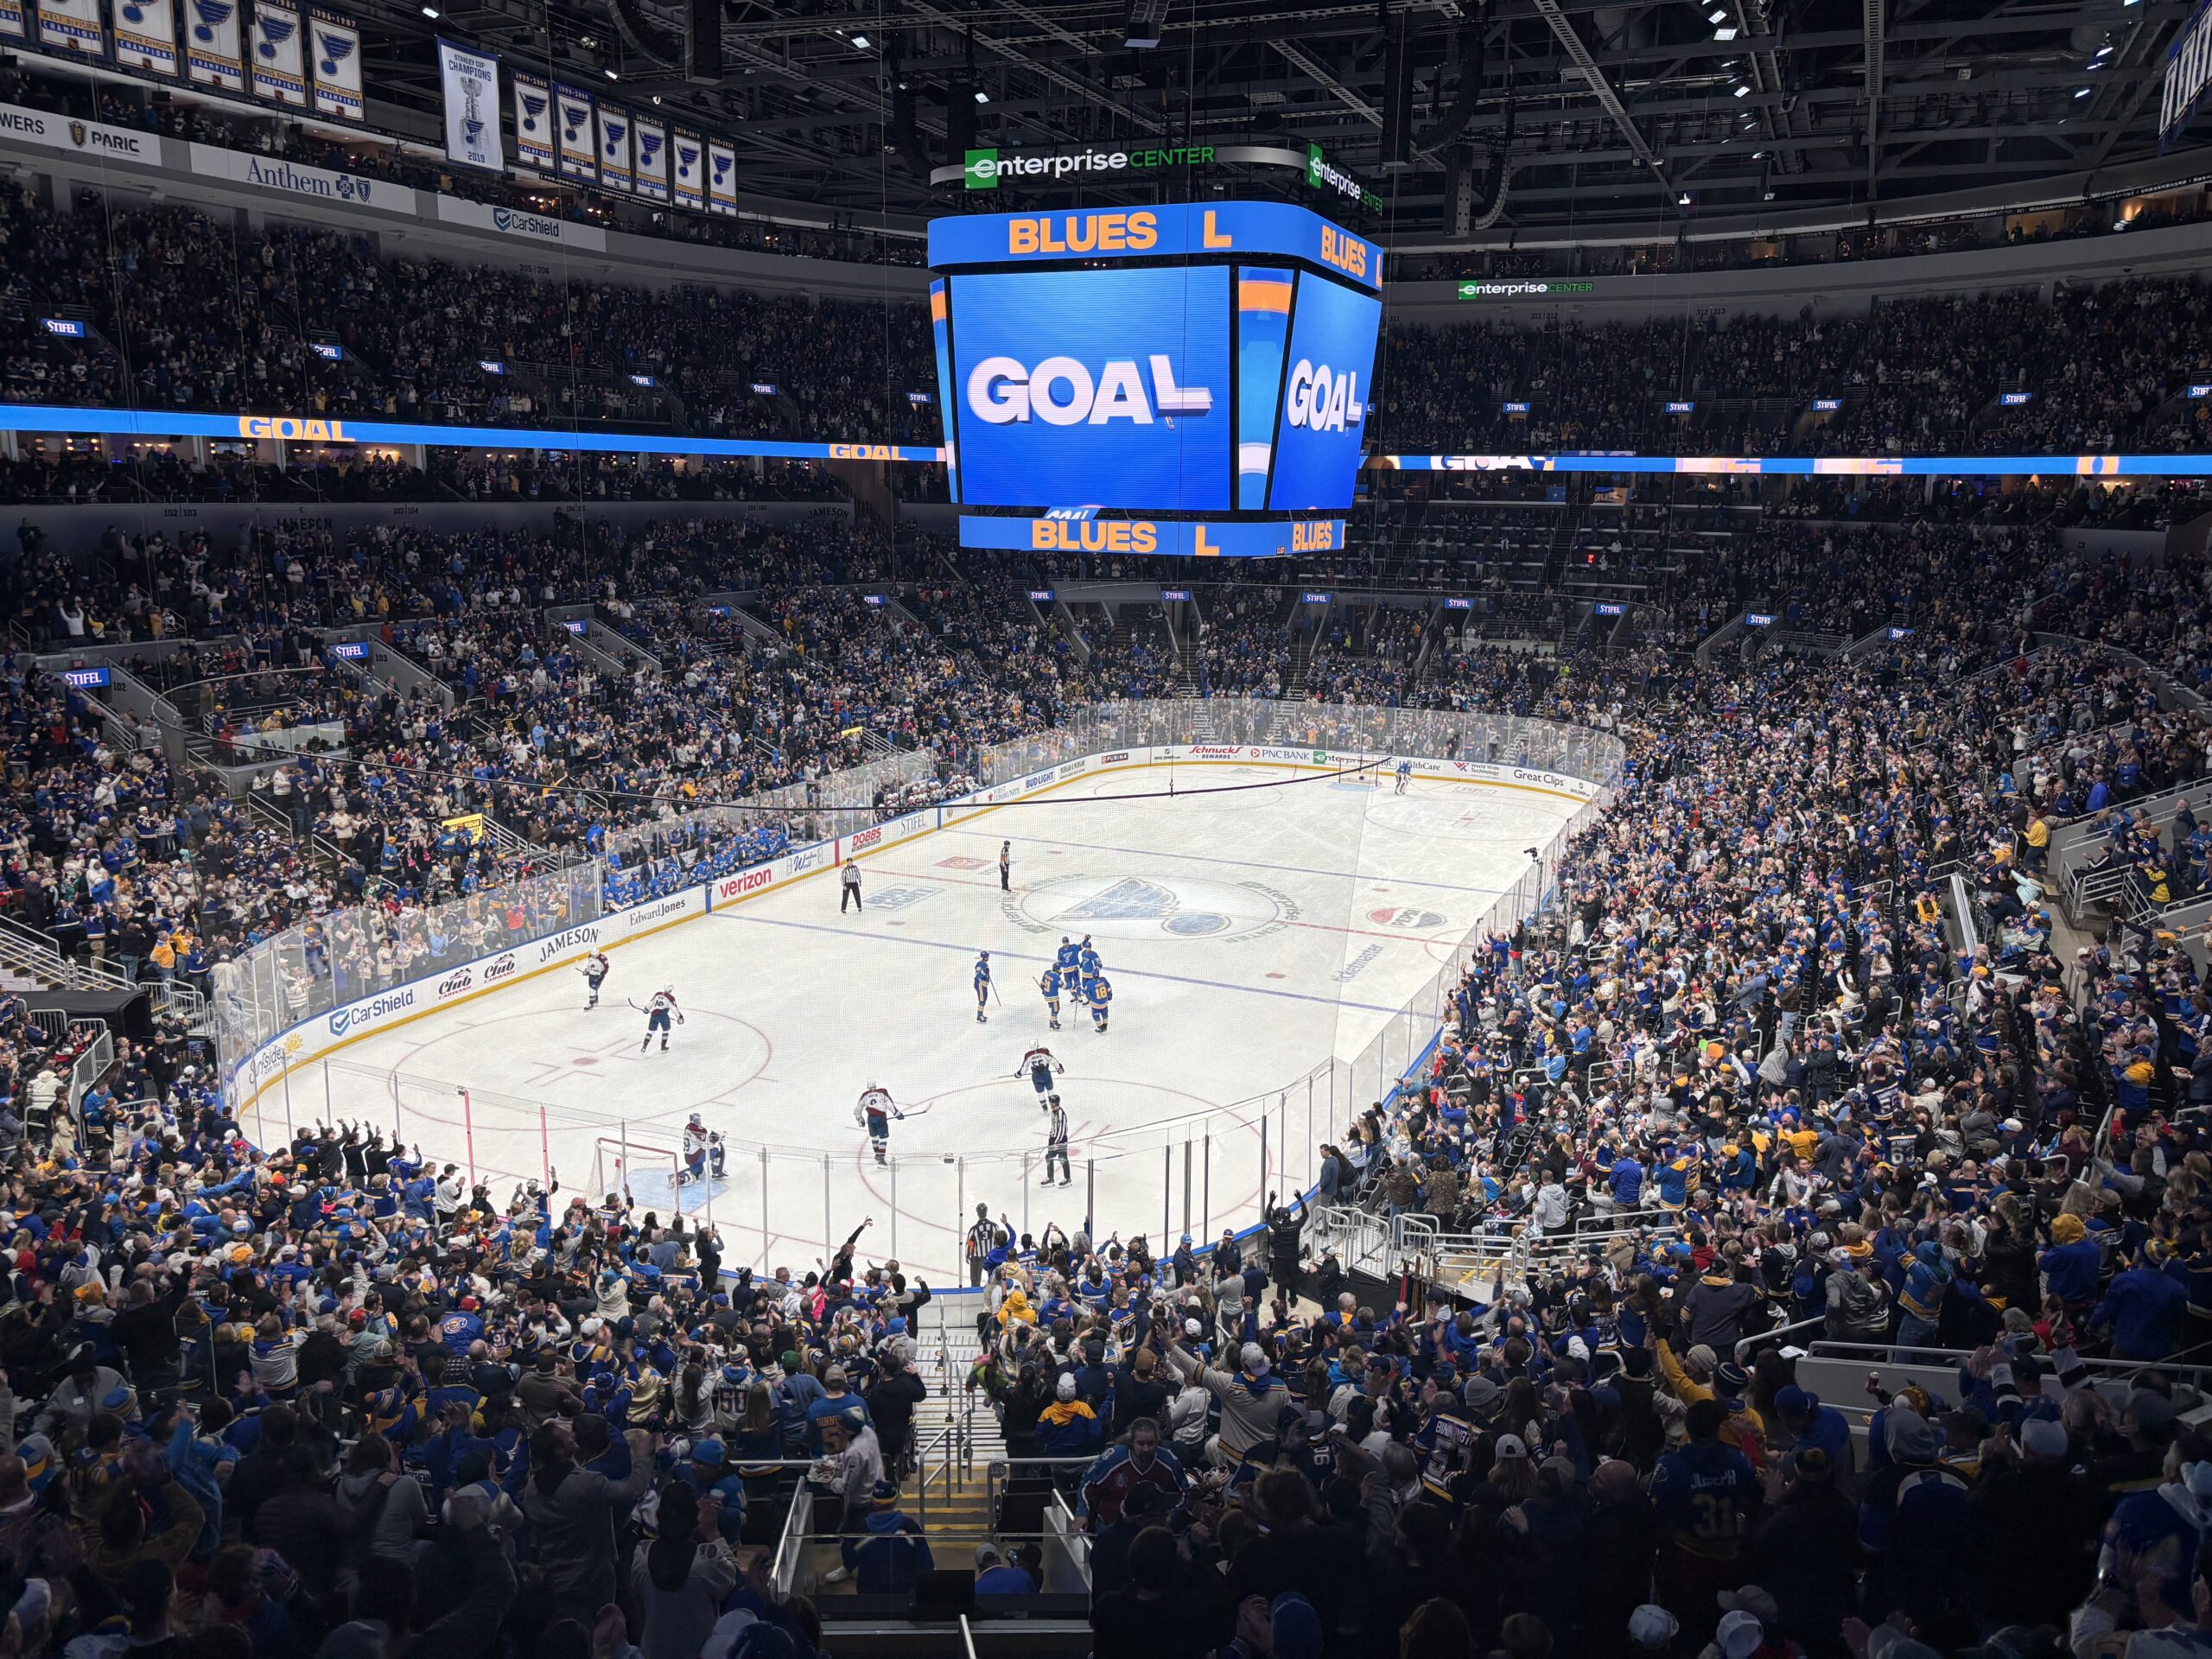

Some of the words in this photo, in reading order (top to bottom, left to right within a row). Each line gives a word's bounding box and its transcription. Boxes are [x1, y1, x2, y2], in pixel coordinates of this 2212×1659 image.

[43, 20, 99, 41] CHAMPIONS
[119, 40, 174, 60] CHAMPIONS
[192, 59, 240, 78] CHAMPIONS
[454, 54, 475, 66] STANLEY
[277, 72, 302, 84] DIVISION
[448, 60, 492, 82] CHAMPIONS
[256, 74, 302, 92] CHAMPIONS
[318, 90, 362, 107] CHAMPIONS
[339, 89, 360, 100] DIVISION
[92, 131, 140, 153] PARIC
[467, 151, 486, 162] 2019
[519, 144, 553, 159] CHAMPIONS
[965, 149, 1128, 178] enterprise
[1129, 146, 1215, 168] CENTER
[247, 156, 331, 196] Anthem
[1310, 156, 1360, 200] enterprise
[1360, 188, 1382, 213] CENTER
[512, 216, 559, 237] CarShield
[1009, 212, 1157, 253] BLUES
[1203, 211, 1232, 248] L
[1321, 225, 1366, 277] BLUES
[1459, 282, 1548, 296] enterprise
[1548, 282, 1594, 292] CENTER
[47, 321, 78, 334] STIFEL
[753, 385, 772, 393] STIFEL
[910, 393, 927, 402] STIFEL
[968, 354, 1212, 426] GOAL
[1287, 359, 1362, 433] GOAL
[1817, 401, 1837, 410] STIFEL
[239, 416, 354, 442] GOAL
[829, 444, 908, 461] GOAL
[164, 508, 178, 517] 102
[184, 508, 197, 518] 103
[808, 506, 849, 519] JAMESON
[276, 518, 332, 530] JAMESON
[1033, 520, 1157, 552] BLUES
[1194, 525, 1219, 556] L
[1292, 522, 1332, 551] BLUES
[1306, 594, 1326, 602] STIFEL
[1449, 599, 1469, 607] STIFEL
[1600, 605, 1621, 613] STIFEL
[336, 645, 363, 657] STIFEL
[375, 654, 388, 663] 103
[65, 672, 102, 685] STIFEL
[113, 682, 126, 691] 102
[1189, 746, 1243, 754] Schnucks
[1262, 749, 1283, 759] PNC
[1284, 751, 1309, 760] BANK
[1026, 776, 1038, 789] BUD
[1038, 772, 1054, 785] LIGHT
[1471, 768, 1499, 777] Technology
[1514, 770, 1542, 782] Great
[1543, 774, 1565, 787] Clips
[994, 787, 1020, 803] COMMUNITY
[995, 786, 1006, 796] FIRST
[900, 814, 926, 834] STIFEL
[852, 827, 881, 847] DOBBS
[720, 868, 772, 899] verizon
[630, 904, 661, 926] Edward
[660, 898, 686, 917] Jones
[1391, 908, 1422, 927] PEPSI
[540, 928, 599, 962] JAMESON
[484, 959, 516, 979] Club
[1331, 944, 1384, 982] ticketmaster
[439, 976, 472, 995] Club
[1096, 986, 1107, 1000] 18
[351, 989, 413, 1026] CarShield
[982, 1230, 988, 1241] 3
[1690, 1469, 1737, 1490] JOSEPH
[1691, 1492, 1735, 1538] 31
